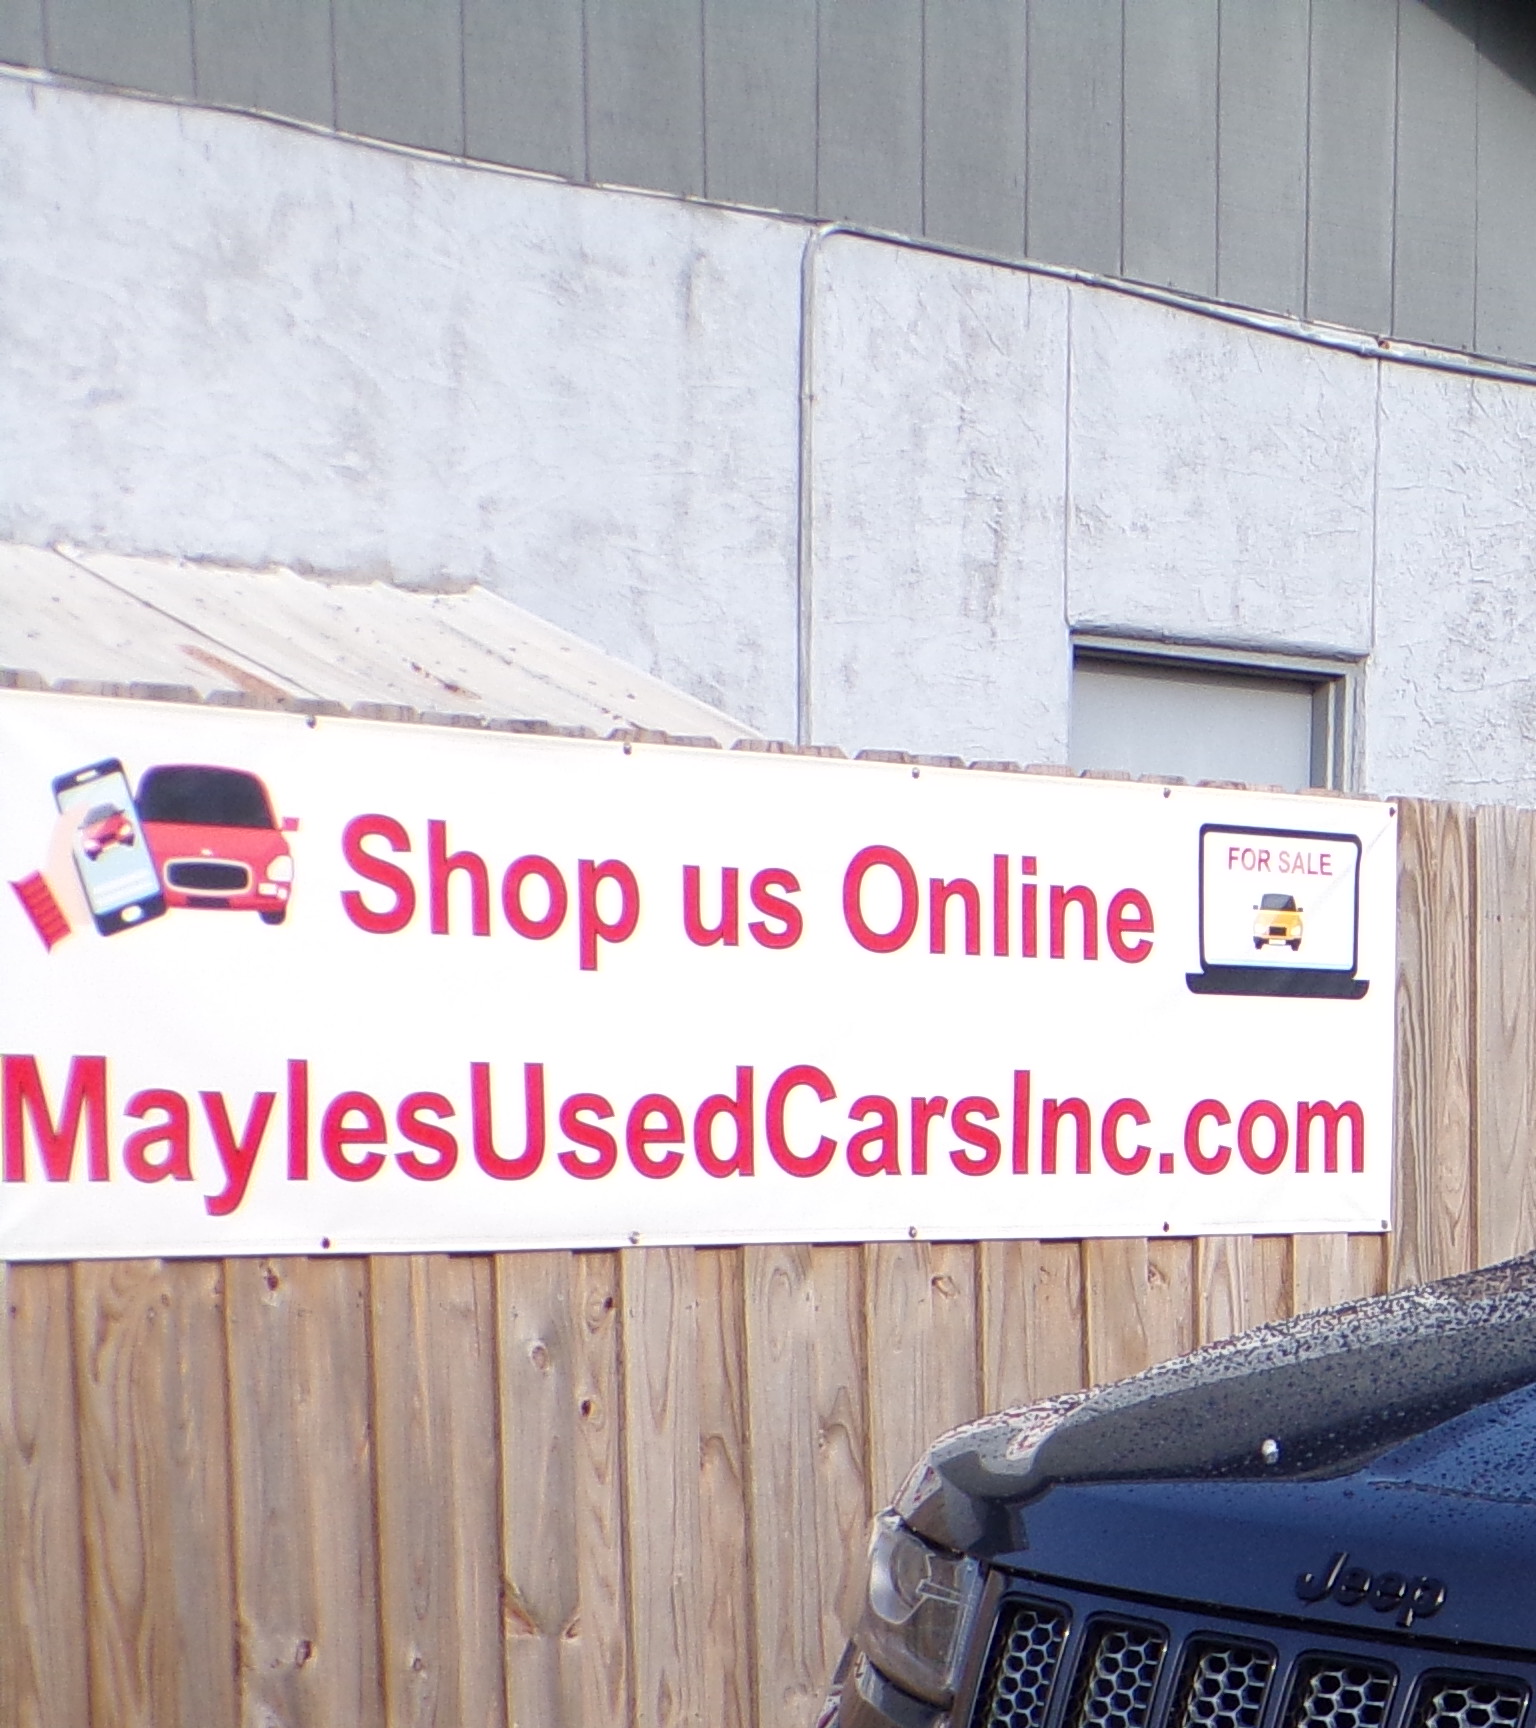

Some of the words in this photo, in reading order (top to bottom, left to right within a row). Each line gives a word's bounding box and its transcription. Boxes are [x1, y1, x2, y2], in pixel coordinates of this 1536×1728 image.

[341, 814, 640, 971] Shop
[682, 865, 803, 950] us
[842, 844, 1155, 965] Online
[1228, 847, 1271, 872] FOR
[1278, 850, 1333, 876] SALE
[1, 1054, 1365, 1217] MaylesUsedCarsInc.com
[1295, 1551, 1448, 1628] Jeep
